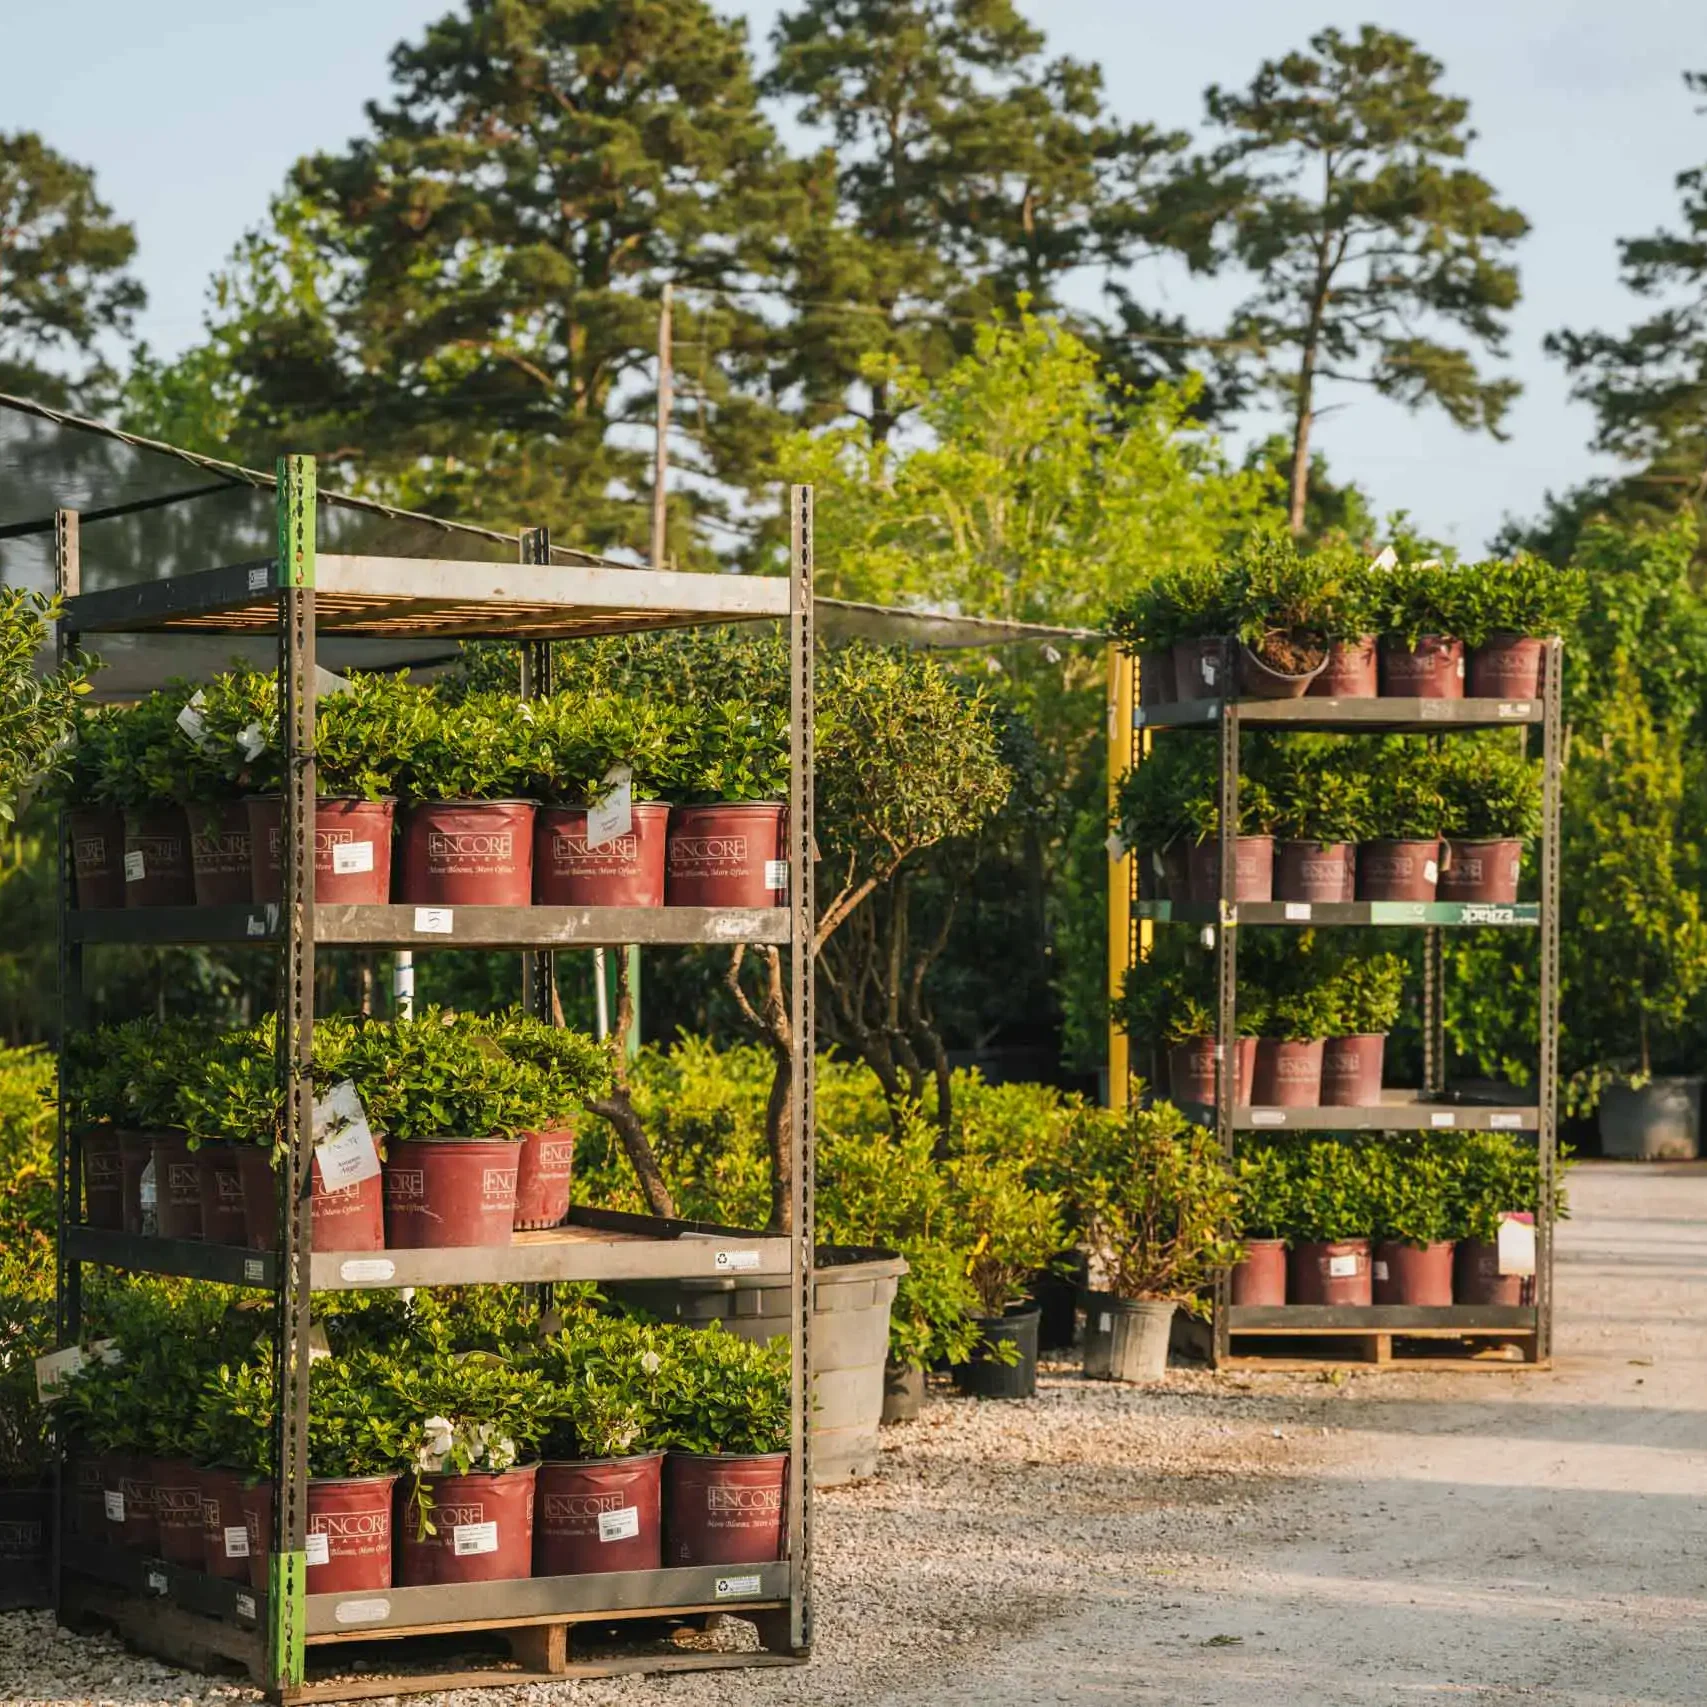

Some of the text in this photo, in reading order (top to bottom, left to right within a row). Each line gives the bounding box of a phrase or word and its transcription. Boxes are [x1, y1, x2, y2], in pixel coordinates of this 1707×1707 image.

[432, 835, 511, 854] ENCORE
[672, 840, 744, 858] ENCORE
[548, 1496, 622, 1516] ENCORE
[711, 1488, 781, 1508] ENCORE
[315, 1514, 388, 1535] ENCORE
